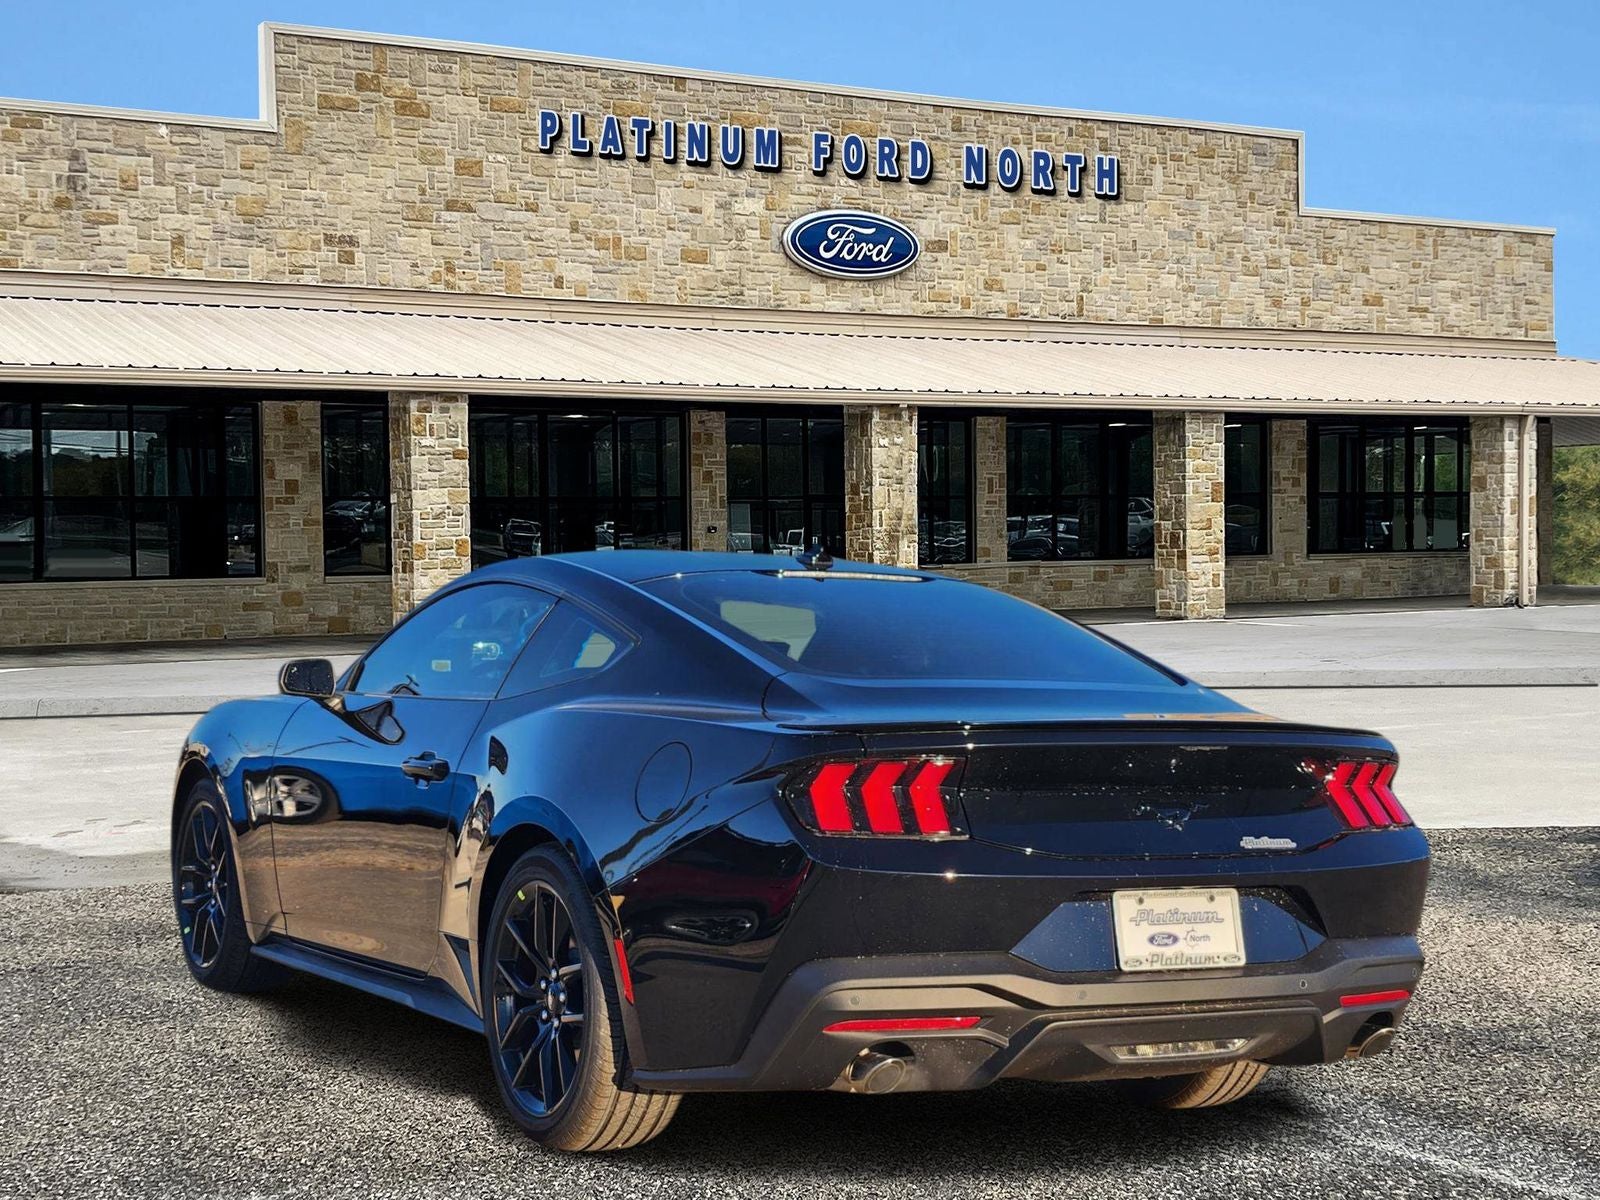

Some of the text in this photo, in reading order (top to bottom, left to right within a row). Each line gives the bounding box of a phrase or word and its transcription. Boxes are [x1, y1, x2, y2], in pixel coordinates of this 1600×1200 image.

[538, 109, 1121, 198] PLATINUM FORD NORTH
[818, 222, 895, 264] Ford
[1129, 908, 1224, 926] Platinum
[1189, 933, 1211, 943] North
[1149, 952, 1219, 967] Platinum
